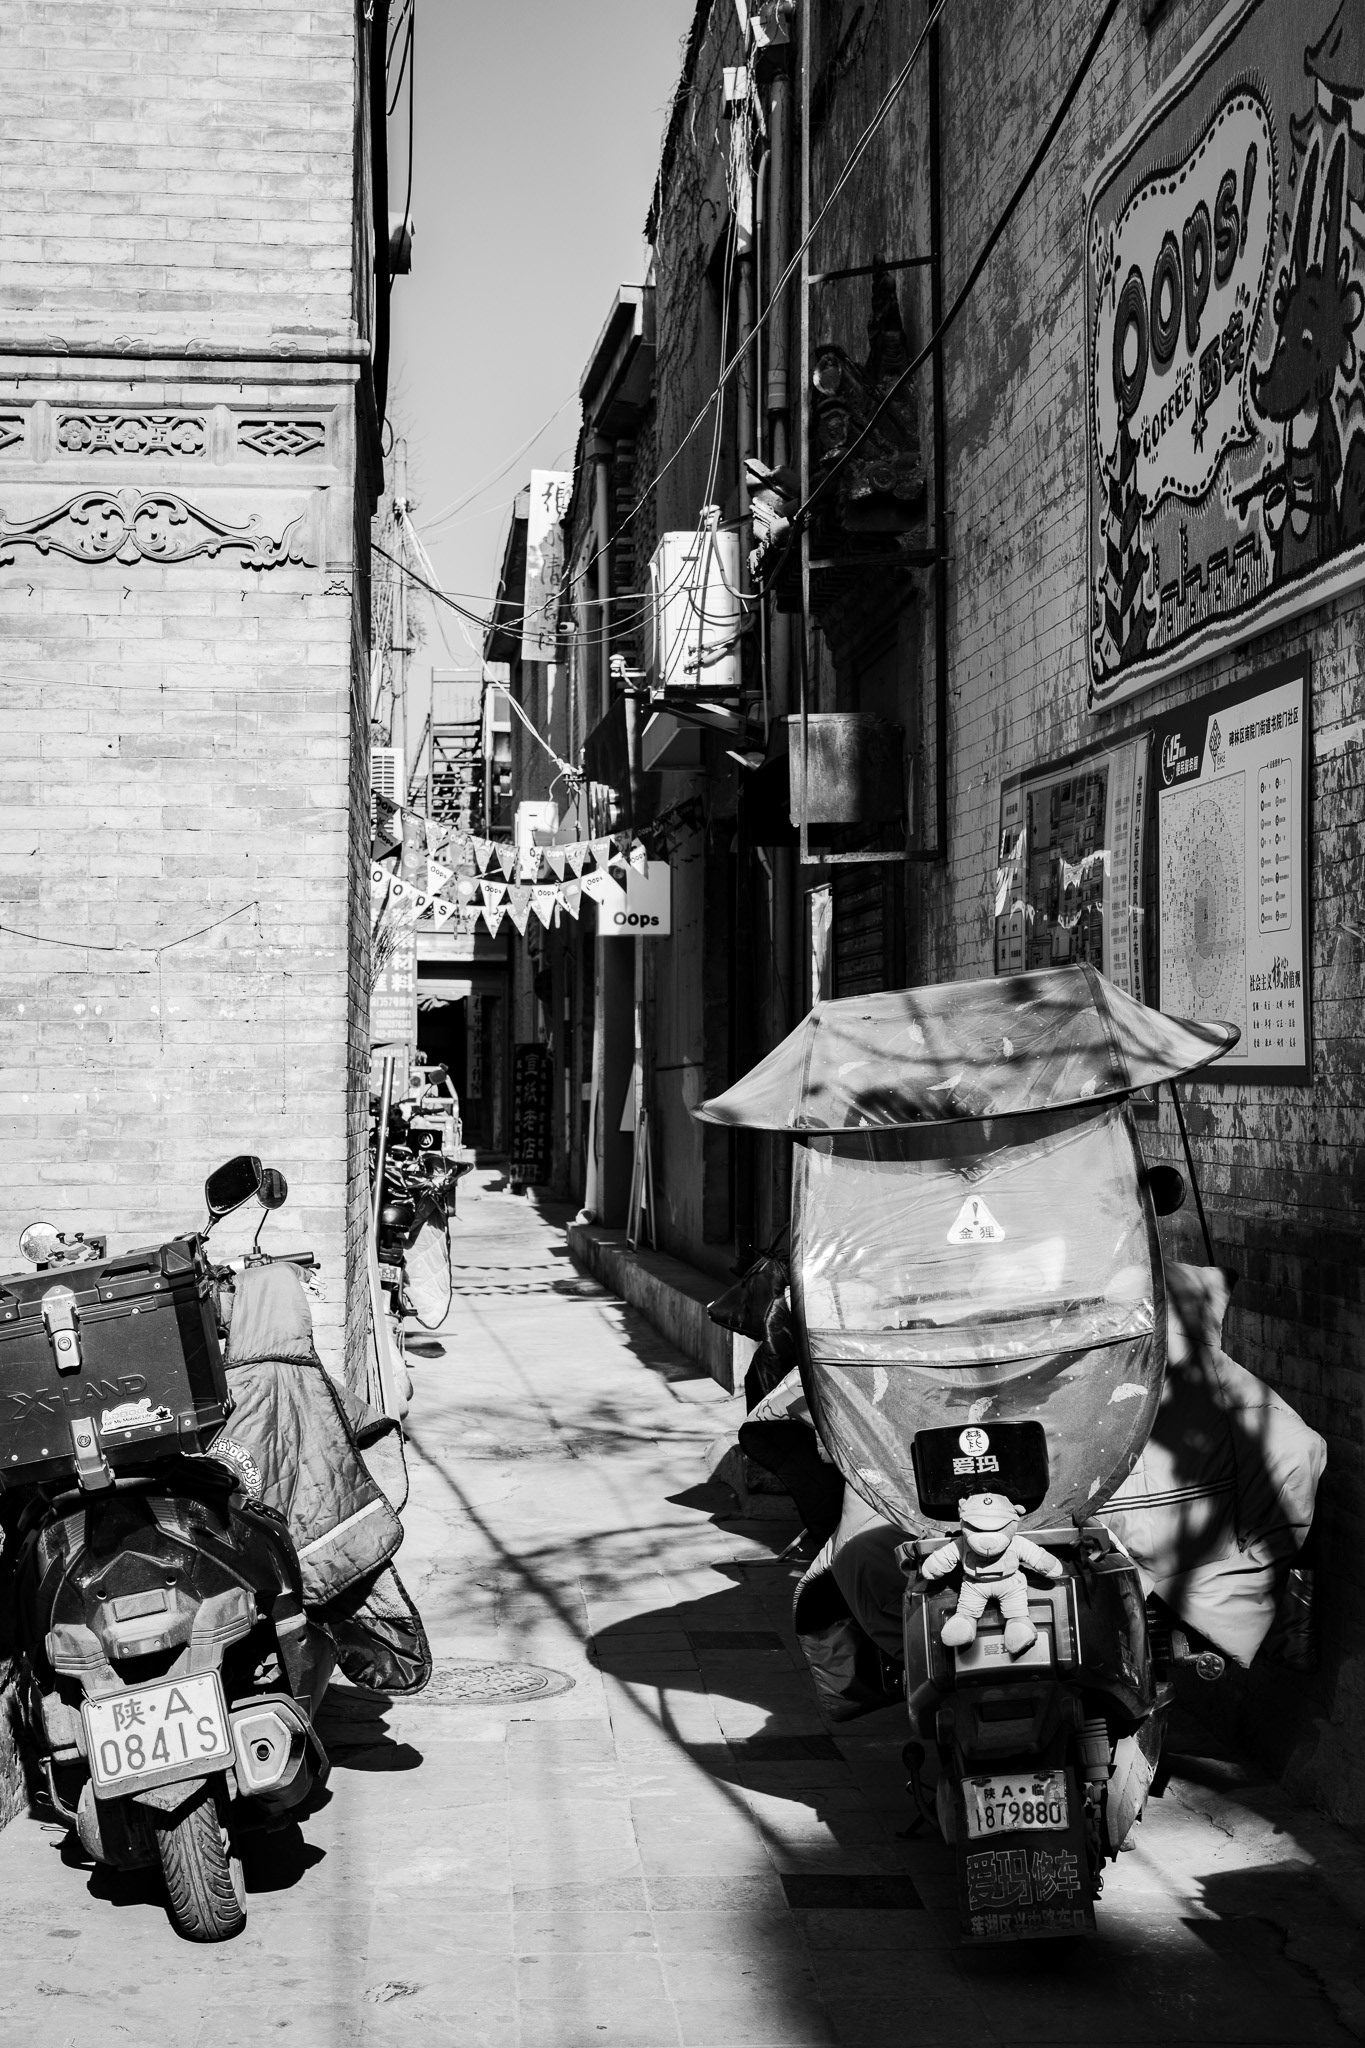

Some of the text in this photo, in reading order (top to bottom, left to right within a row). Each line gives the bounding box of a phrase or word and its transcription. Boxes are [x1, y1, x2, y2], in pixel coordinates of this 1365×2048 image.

[1143, 372, 1193, 457] COFFEE
[1228, 706, 1299, 747] 碑林区南院门街道书院门社区
[959, 1226, 995, 1240] 金狸
[8, 1374, 148, 1421] X-LAND
[952, 1455, 1000, 1475] 爱玛
[100, 1716, 218, 1776] 0841S
[976, 1801, 1062, 1832] 1879880
[966, 1849, 1081, 1911] 爱玛修车
